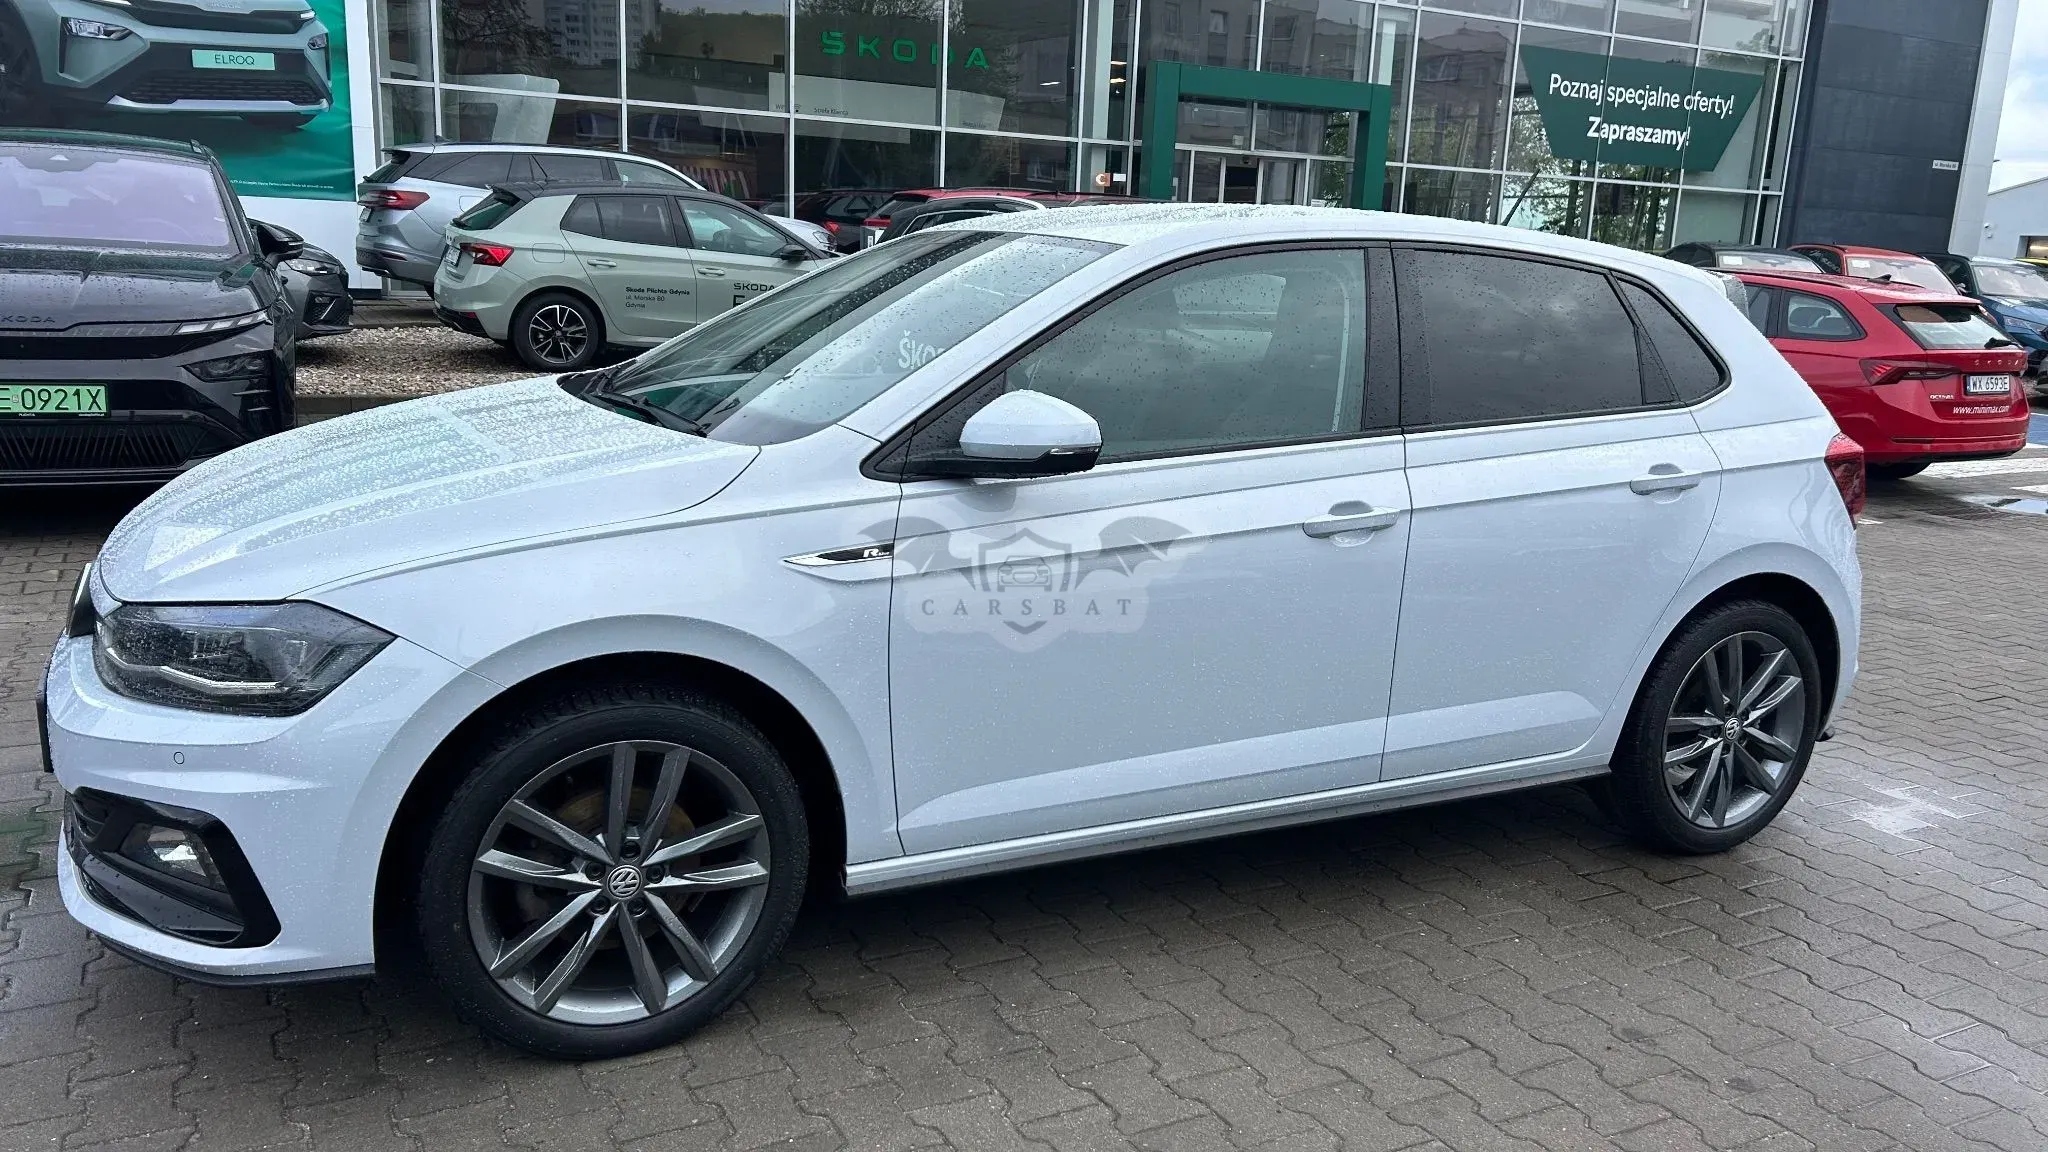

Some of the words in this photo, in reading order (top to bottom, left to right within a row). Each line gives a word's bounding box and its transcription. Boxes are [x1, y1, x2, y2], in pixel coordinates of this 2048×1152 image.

[214, 54, 255, 65] ELROQ
[1549, 73, 1605, 106] Poznaj
[1606, 84, 1680, 111] specjalne
[1683, 91, 1735, 119] oferty!
[1587, 115, 1691, 150] Zapraszamy!
[625, 286, 645, 294] Skoda
[646, 287, 668, 295] Plichta
[669, 288, 691, 296] Gdynia
[625, 301, 646, 309] Gdynia
[1971, 376, 1983, 390] WX
[1985, 376, 2009, 390] 6593E
[21, 387, 103, 411] 0921X
